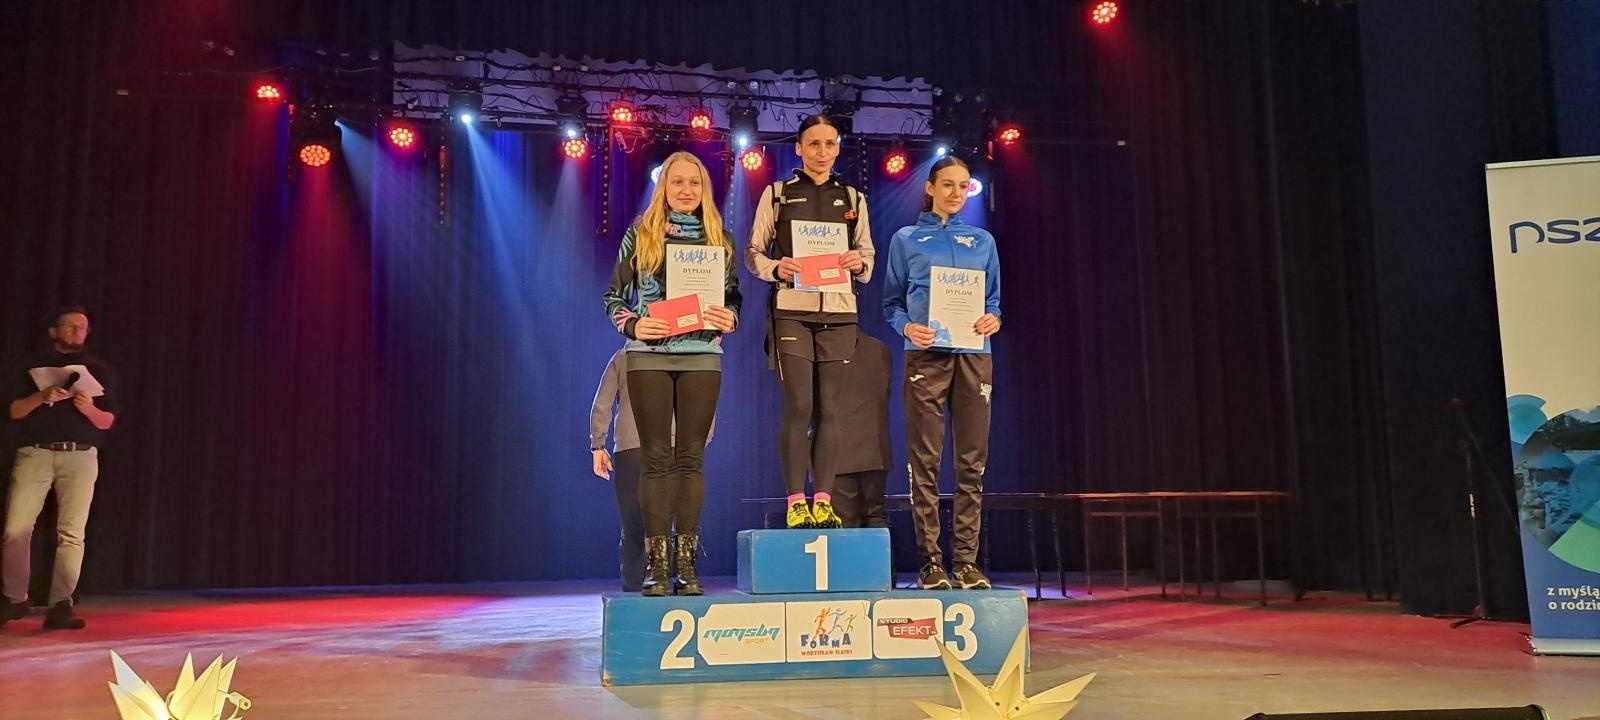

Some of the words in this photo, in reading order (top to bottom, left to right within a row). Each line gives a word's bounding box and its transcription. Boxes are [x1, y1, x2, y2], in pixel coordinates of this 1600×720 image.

[945, 288, 973, 296] DYPLOM
[804, 534, 829, 591] 1
[1546, 587, 1555, 596] z
[1558, 585, 1600, 600] myślą
[1548, 601, 1558, 610] o
[893, 625, 932, 635] EFEKT
[944, 602, 978, 662] 3
[659, 609, 695, 670] 2
